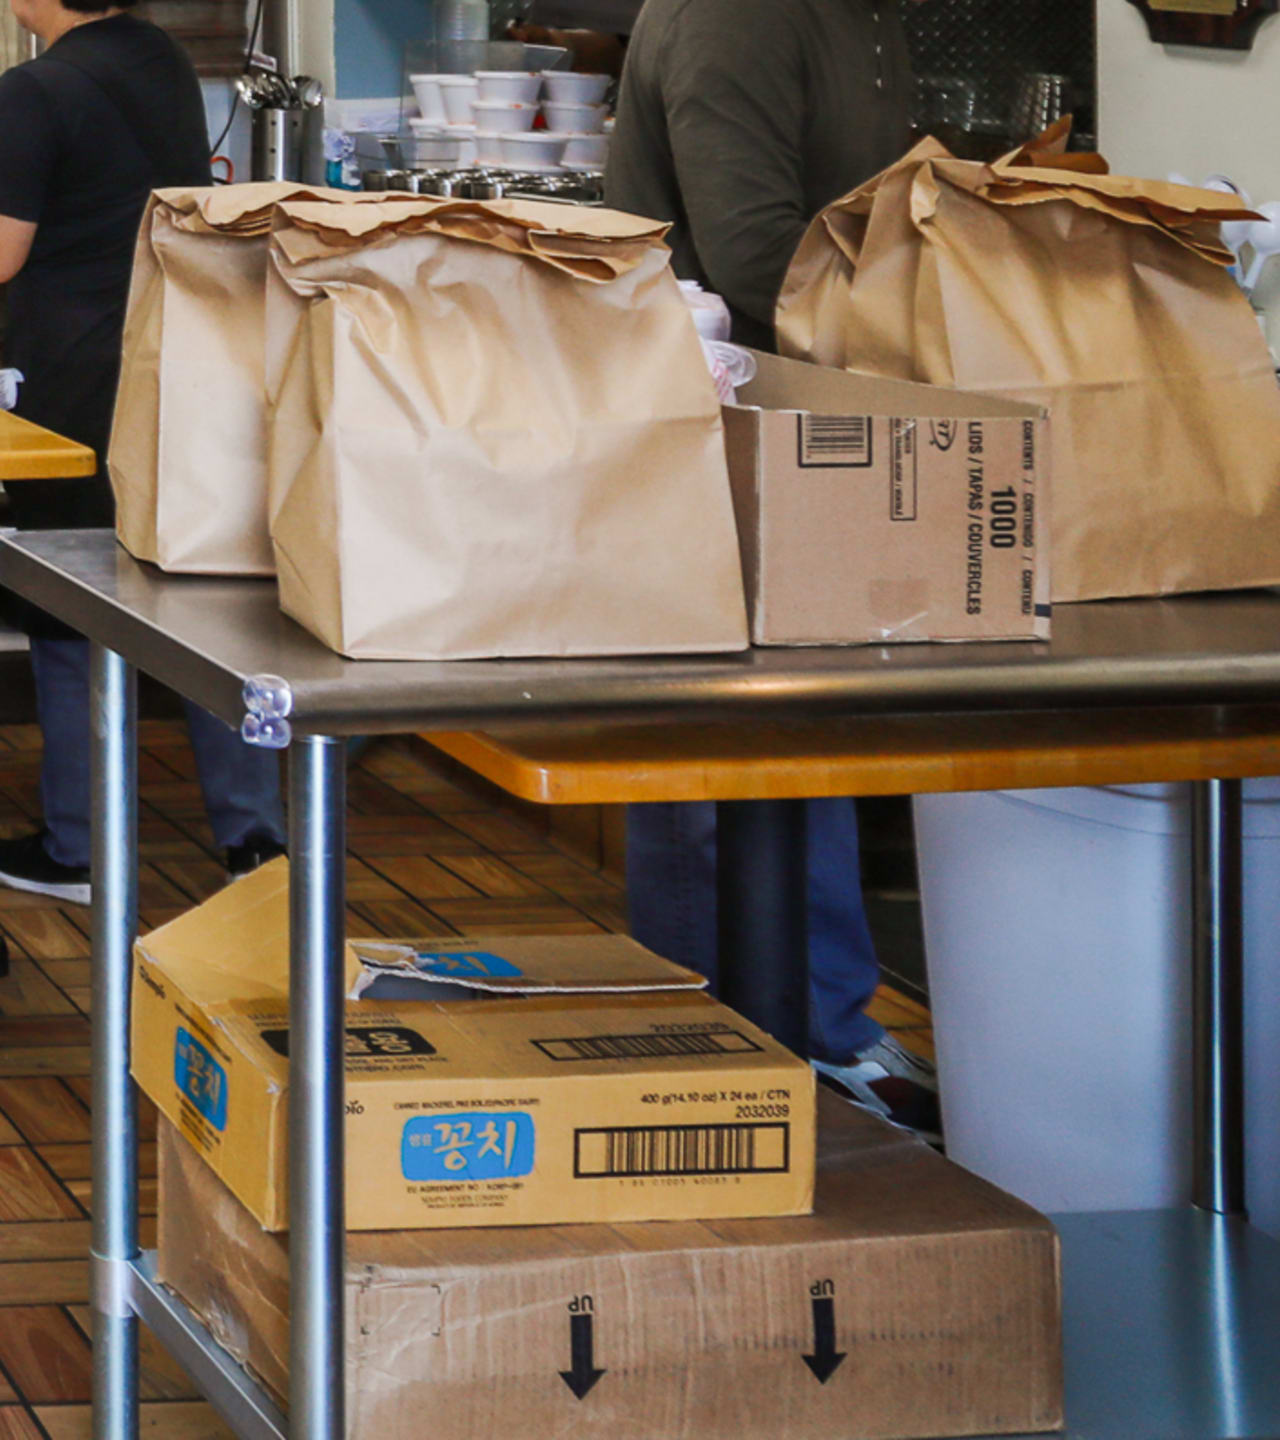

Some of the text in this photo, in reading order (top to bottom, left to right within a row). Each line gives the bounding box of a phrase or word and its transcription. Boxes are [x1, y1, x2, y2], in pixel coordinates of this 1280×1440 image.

[968, 421, 983, 454] LIDS
[1022, 420, 1034, 470] CONTENTS
[967, 466, 983, 511] TAPAS
[990, 485, 1017, 549] 1000
[1022, 492, 1034, 548] CONTENIDO
[966, 522, 983, 616] COUVERCLES
[1021, 569, 1033, 616] CONTENU
[641, 1092, 659, 1104] 400
[720, 1091, 727, 1101] X
[730, 1091, 743, 1101] 24
[744, 1092, 757, 1101] ea
[766, 1089, 790, 1100] CTN
[735, 1104, 790, 1118] 2032039
[432, 1120, 517, 1171] 꽁치
[567, 1294, 594, 1312] UP
[809, 1278, 835, 1296] UP
